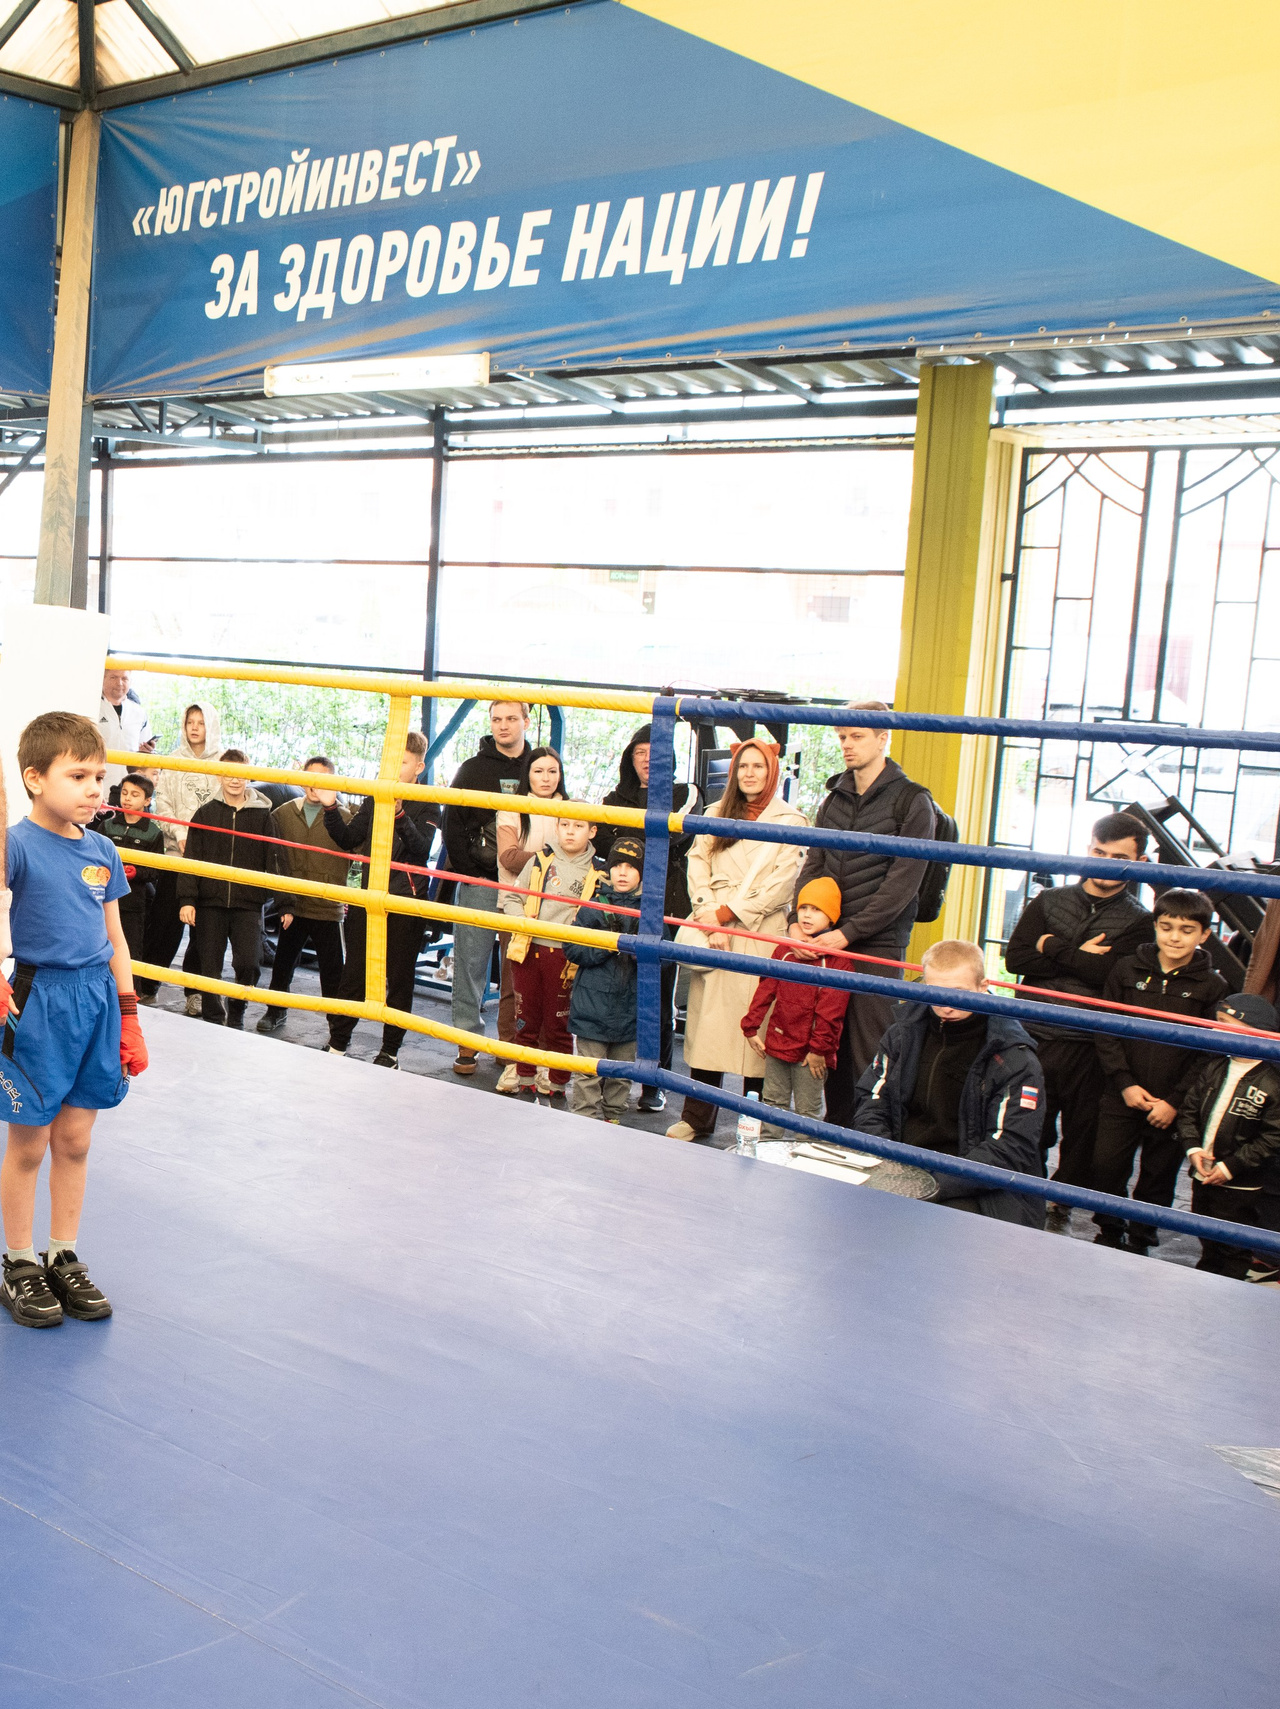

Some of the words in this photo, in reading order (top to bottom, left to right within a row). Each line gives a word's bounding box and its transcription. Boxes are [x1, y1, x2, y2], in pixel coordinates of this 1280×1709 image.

[132, 135, 482, 236] «ЮГСТРОЙИНВЕСТ»
[204, 252, 258, 320] ЗА
[273, 209, 553, 322] ЗДОРОВЬЕ
[561, 172, 826, 285] НАЦИИ!
